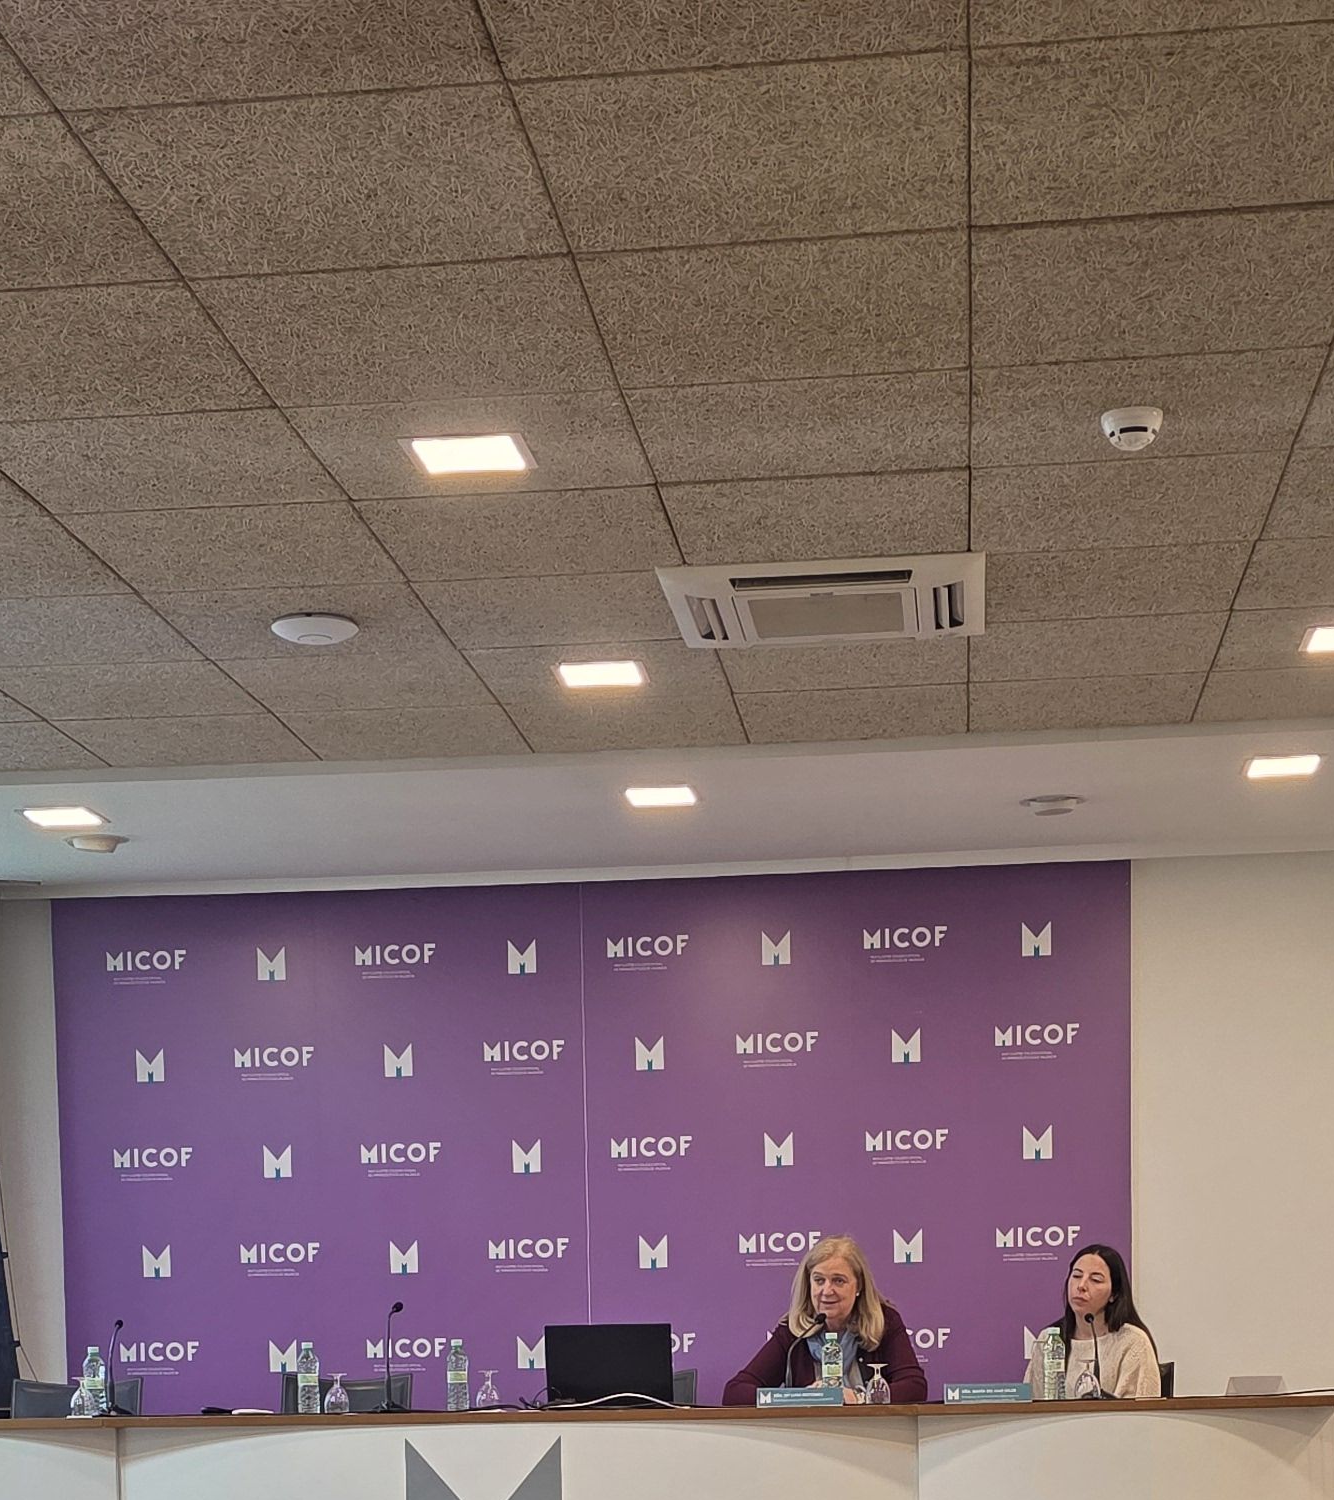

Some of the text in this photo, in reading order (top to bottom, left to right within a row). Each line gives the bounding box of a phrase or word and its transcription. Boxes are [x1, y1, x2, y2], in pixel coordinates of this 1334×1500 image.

[607, 935, 688, 957] MICOF
[762, 931, 790, 965] M
[864, 926, 947, 949] MICOF
[1022, 922, 1051, 956] M
[106, 950, 186, 971] MICOF
[257, 947, 285, 980] M
[355, 944, 435, 965] MICOF
[508, 940, 536, 974] M
[484, 1040, 564, 1061] MICOF
[736, 1032, 818, 1053] MICOF
[892, 1028, 920, 1062] M
[995, 1024, 1079, 1046] MICOF
[136, 1049, 164, 1082] M
[235, 1047, 313, 1067] MICOF
[384, 1044, 412, 1077] M
[635, 1036, 664, 1070] M
[361, 1142, 441, 1163] MICOF
[611, 1136, 692, 1158] MICOF
[764, 1132, 793, 1166] M
[866, 1129, 948, 1151] MICOF
[1023, 1125, 1052, 1159] M
[114, 1148, 192, 1167] MICOF
[263, 1145, 292, 1178] M
[512, 1140, 541, 1173] M
[489, 1238, 568, 1259] MICOF
[639, 1235, 667, 1268] M
[739, 1232, 820, 1253] MICOF
[893, 1229, 922, 1263] M
[996, 1226, 1080, 1247] MICOF
[143, 1245, 171, 1277] M
[240, 1243, 319, 1263] MICOF
[390, 1240, 418, 1273] M
[120, 1342, 199, 1362] MICOF
[269, 1340, 297, 1372] M
[517, 1336, 546, 1368] M
